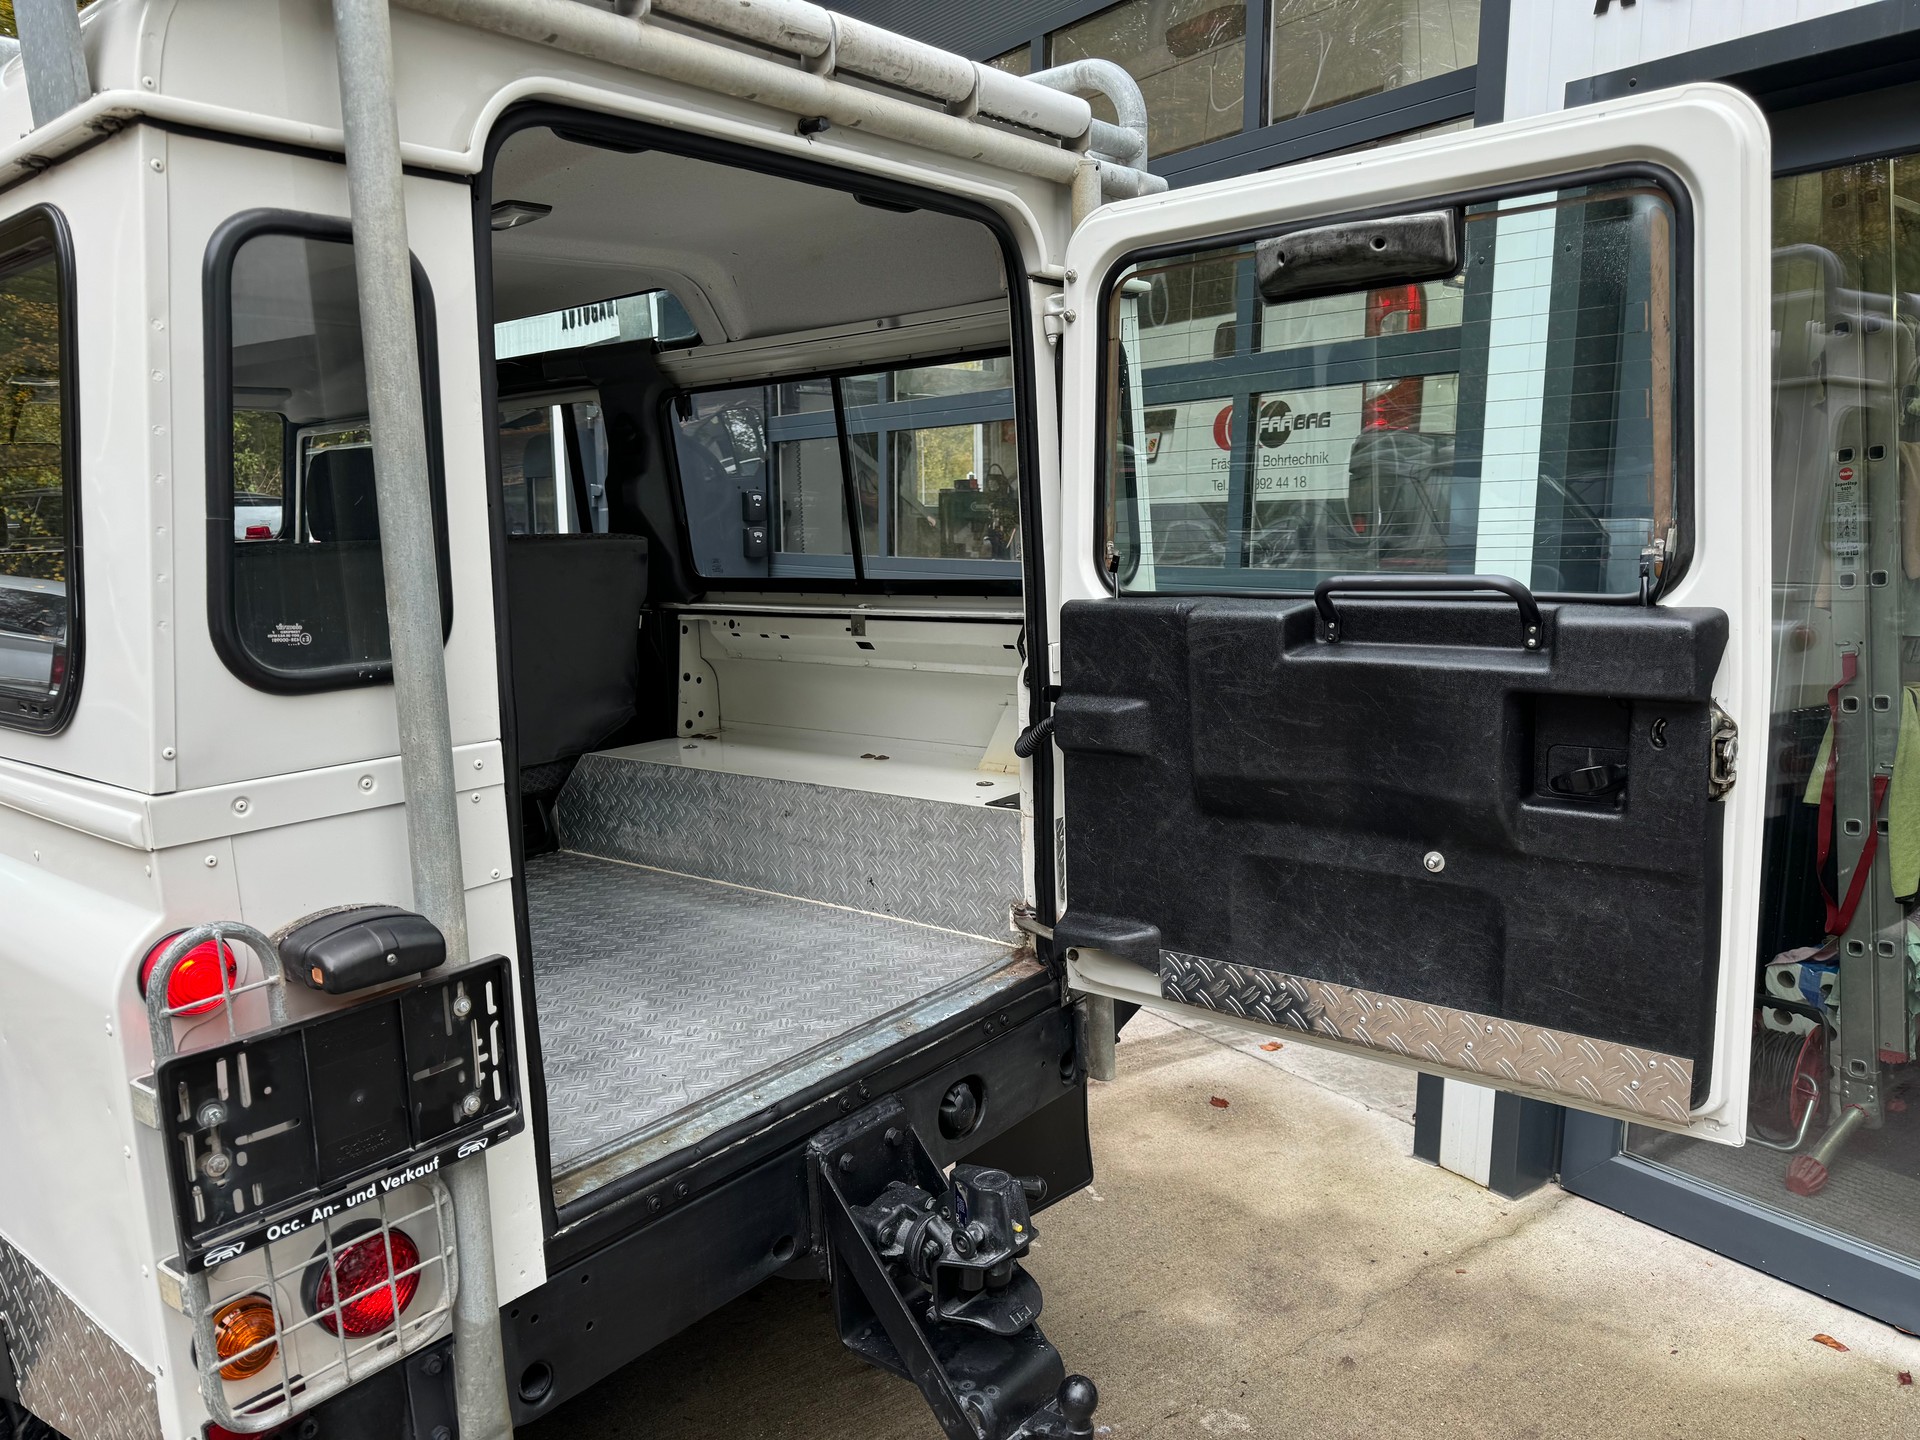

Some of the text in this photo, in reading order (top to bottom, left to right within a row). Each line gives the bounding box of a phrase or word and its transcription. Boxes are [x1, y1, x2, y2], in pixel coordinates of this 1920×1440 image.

[1263, 451, 1329, 467] Bohrtechnik
[1211, 479, 1229, 492] Tel.
[1276, 477, 1289, 489] 44
[1293, 475, 1307, 488] 18
[266, 1218, 306, 1242] Occ.
[311, 1202, 341, 1223] An-
[346, 1184, 377, 1208] und
[380, 1156, 440, 1193] Verkauf
